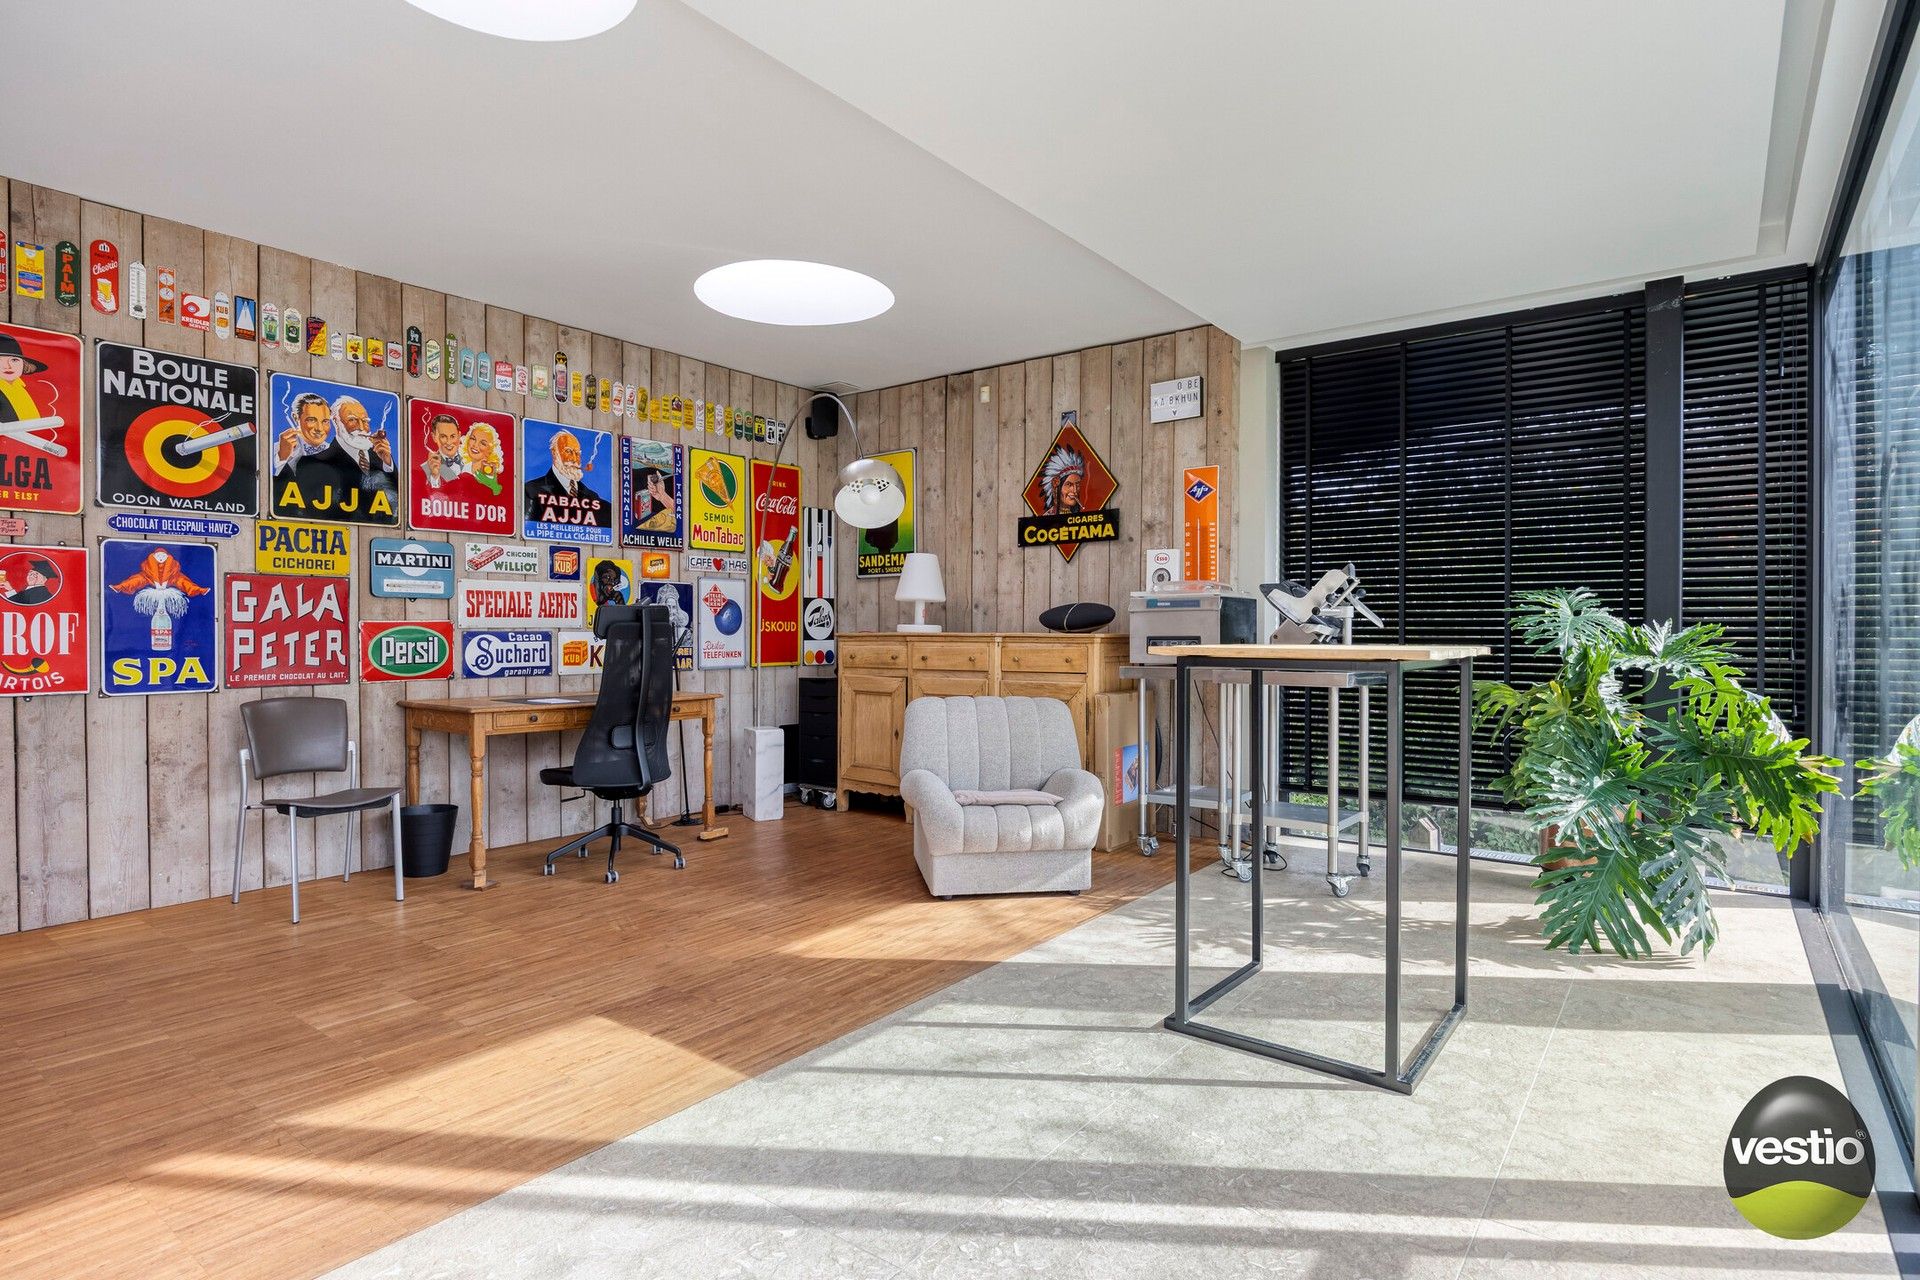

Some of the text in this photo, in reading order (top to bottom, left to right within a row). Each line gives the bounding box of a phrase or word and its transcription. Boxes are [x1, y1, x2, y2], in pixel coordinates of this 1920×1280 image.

[61, 253, 76, 293] PALM
[181, 316, 210, 326] KREIDLER
[133, 350, 228, 389] BOULE
[104, 369, 253, 414] NATIONALE
[622, 438, 631, 526] LE BOHANNAIS
[112, 492, 245, 513] ODON WARLAND
[278, 481, 393, 516] AJJA
[538, 494, 601, 510] TABACS
[675, 483, 683, 519] TABAK
[421, 498, 507, 523] BOULE D'OR
[542, 508, 597, 526] AJJA
[703, 512, 735, 524] SEMOIS
[116, 517, 159, 530] CHOCOLAT
[1067, 514, 1104, 526] CIGARES
[536, 530, 554, 539] PIPE
[563, 532, 572, 540] LA
[573, 532, 610, 543] CIGARETTE
[550, 523, 583, 533] MEILLEURS
[586, 527, 601, 535] POUR
[258, 526, 348, 555] PACHA
[623, 535, 683, 548] ACHILLE WELLE
[273, 557, 335, 571] CICHOREI
[377, 553, 450, 568] MARTINI
[555, 560, 571, 573] KUB
[729, 560, 747, 569] HAG
[231, 580, 345, 624] GALA
[466, 589, 578, 619] SPECIALE AERTS
[761, 619, 797, 632] JSKOUD
[508, 632, 542, 642] Cacao
[232, 628, 346, 673] PETER
[381, 635, 439, 667] Persil
[472, 637, 546, 676] Suchard
[564, 654, 580, 664] KUB
[703, 650, 742, 659] TELEFUNKEN
[112, 656, 210, 686] SPA
[230, 674, 240, 682] LE
[243, 673, 276, 681] PREMIER
[279, 673, 314, 681] CHOCOLAT
[0, 671, 65, 691] RTOIS
